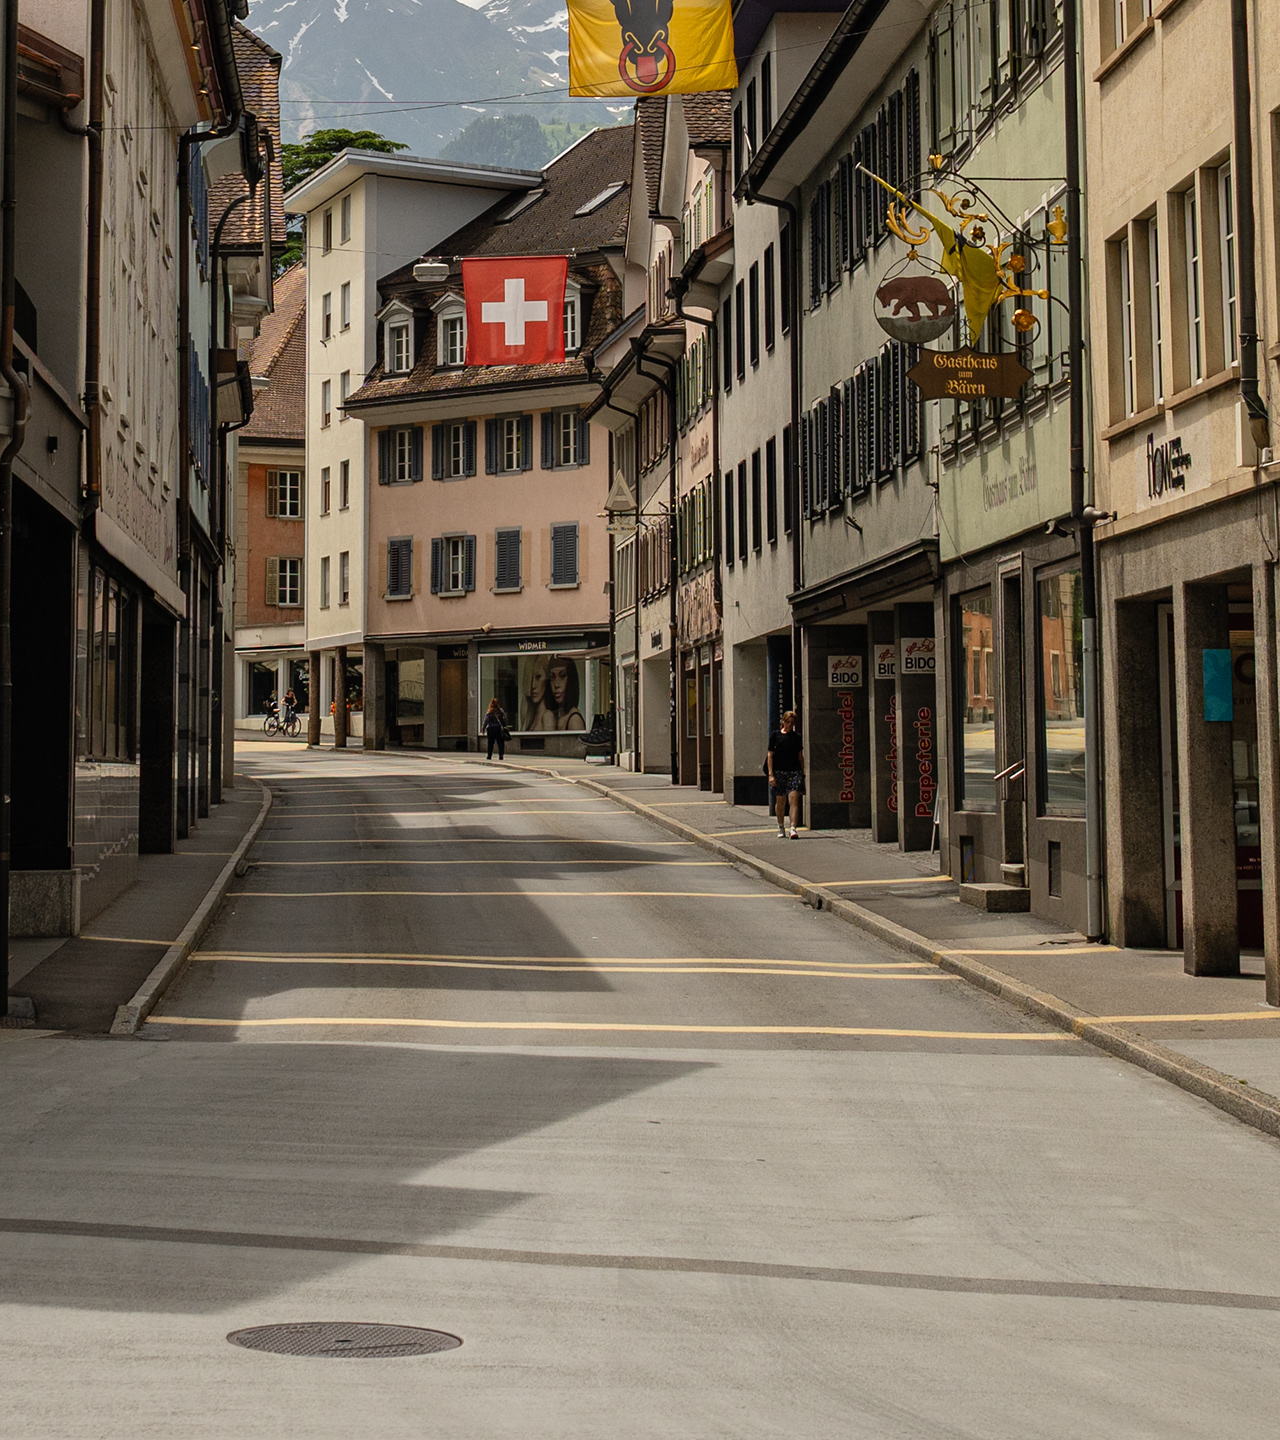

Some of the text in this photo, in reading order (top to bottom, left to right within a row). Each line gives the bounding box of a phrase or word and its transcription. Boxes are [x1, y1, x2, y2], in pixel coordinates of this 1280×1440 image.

[933, 353, 998, 369] Gasthaus
[945, 379, 986, 394] Bären
[905, 657, 936, 670] BIDO
[831, 672, 859, 683] BIDO
[838, 691, 854, 802] Buchhandel
[914, 706, 936, 817] Papeterie
